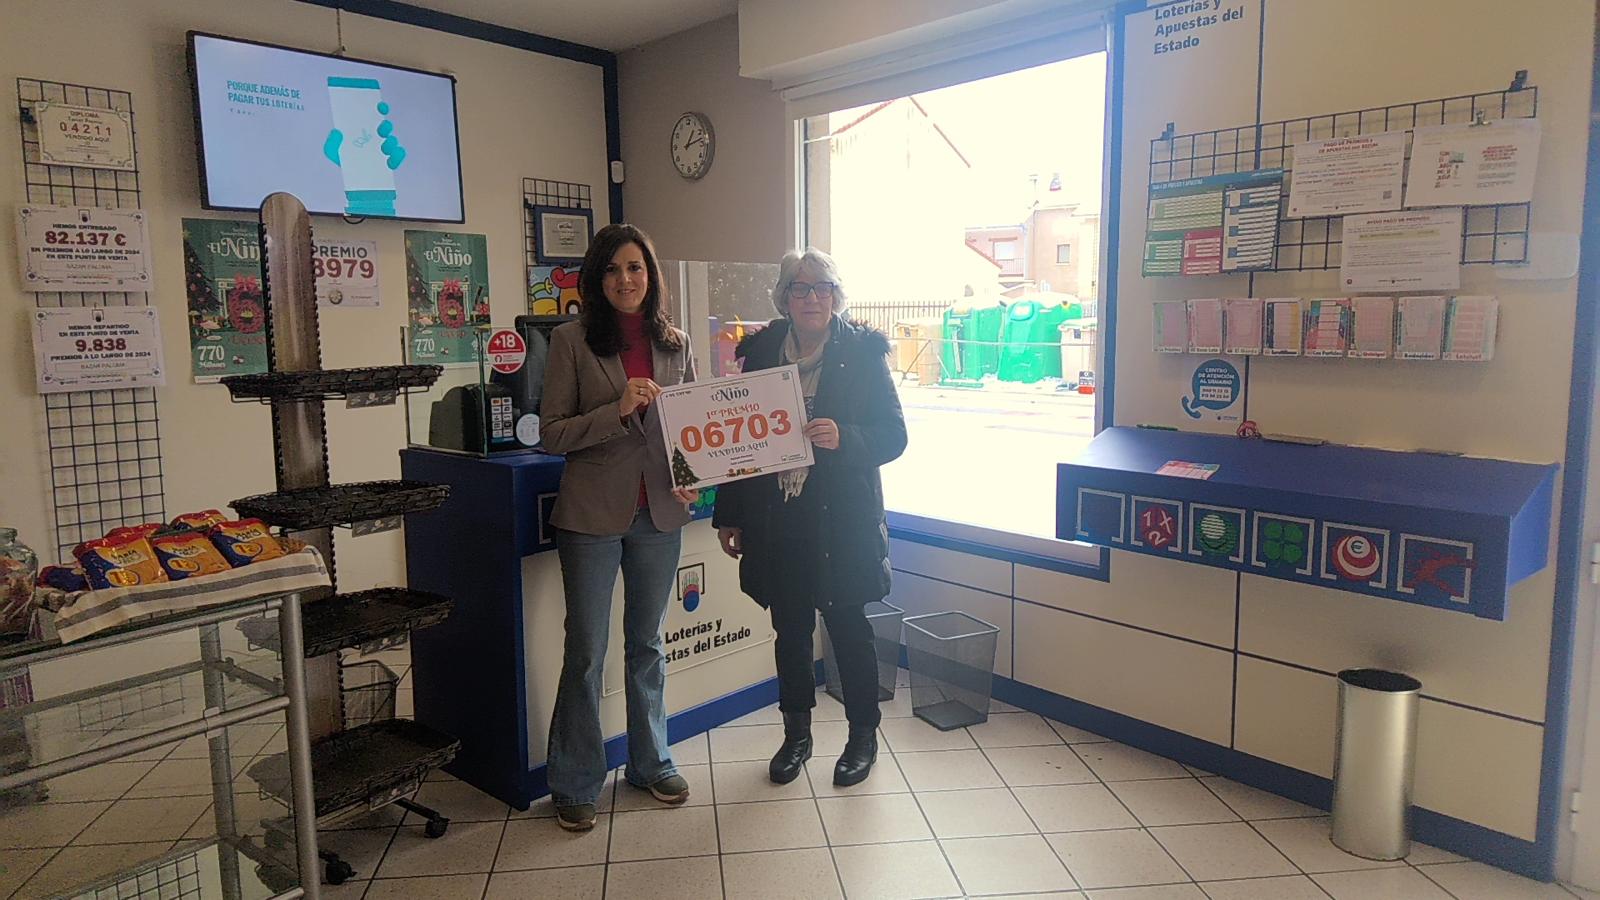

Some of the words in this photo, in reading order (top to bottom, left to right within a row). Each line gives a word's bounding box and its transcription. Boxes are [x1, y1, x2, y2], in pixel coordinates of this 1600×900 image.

[1155, 14, 1217, 37] Apuestas
[1222, 6, 1244, 22] del
[1154, 36, 1200, 54] Estado
[227, 80, 258, 93] PORQUE
[260, 84, 290, 97] ADEMÁS
[291, 89, 301, 99] DE
[228, 92, 254, 104] PAGAR
[256, 96, 270, 106] TUS
[60, 122, 112, 136] 04211
[45, 230, 109, 246] 82.137
[114, 233, 126, 246] €
[220, 237, 260, 260] Niñ
[312, 245, 368, 258] PREMIO
[433, 246, 472, 267] Niño
[75, 338, 126, 352] 9.838
[415, 338, 434, 352] 770
[494, 334, 516, 348] +18
[197, 345, 224, 360] 770
[718, 387, 749, 402] Niño
[720, 402, 760, 418] PREMIO
[680, 409, 792, 452] 06703
[708, 446, 746, 458] VENDIDO
[665, 620, 713, 645] Loterías
[716, 618, 722, 632] y
[665, 647, 690, 664] stas
[694, 637, 710, 654] del
[714, 626, 750, 648] Estado
